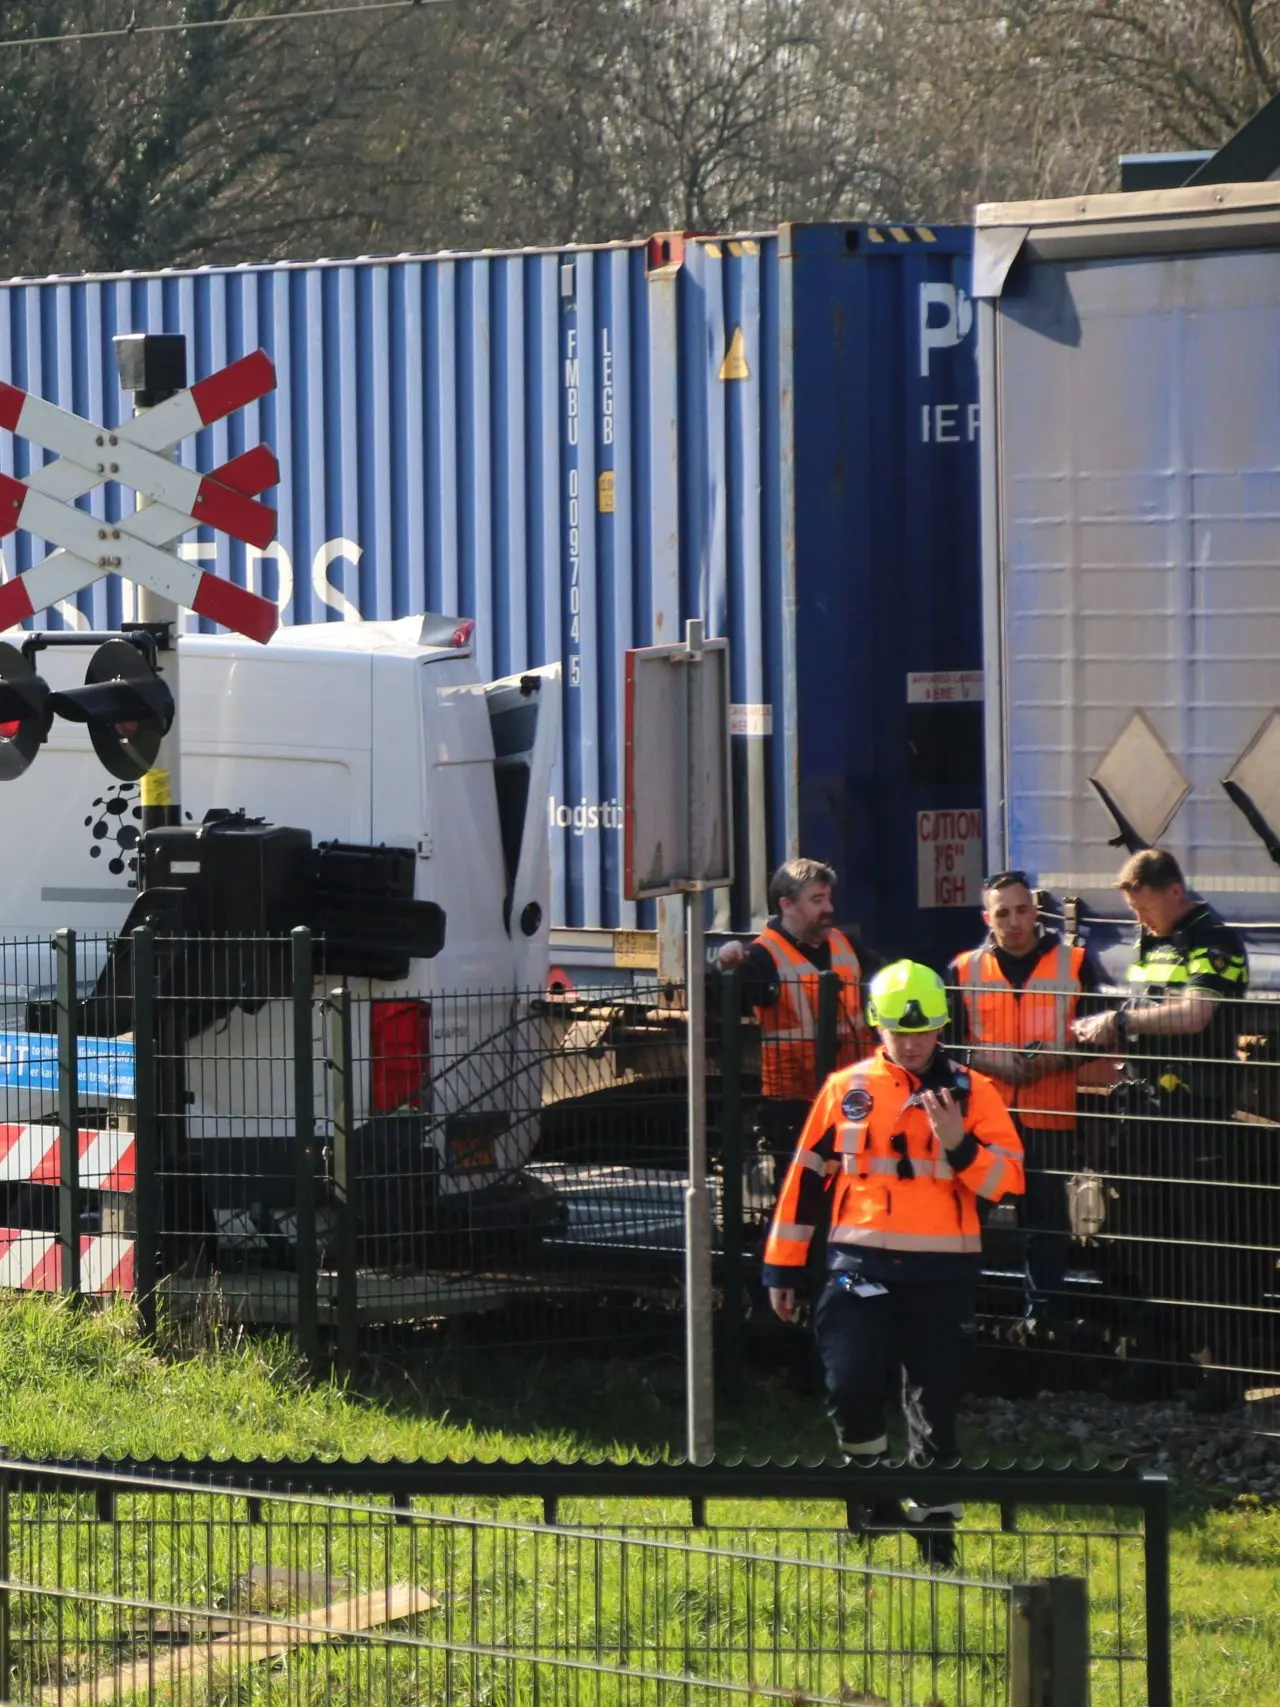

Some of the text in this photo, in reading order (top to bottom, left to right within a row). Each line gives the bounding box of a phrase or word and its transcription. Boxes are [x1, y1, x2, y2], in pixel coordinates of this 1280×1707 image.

[603, 327, 613, 445] LEGB
[566, 329, 581, 685] FMBU 009704 5
